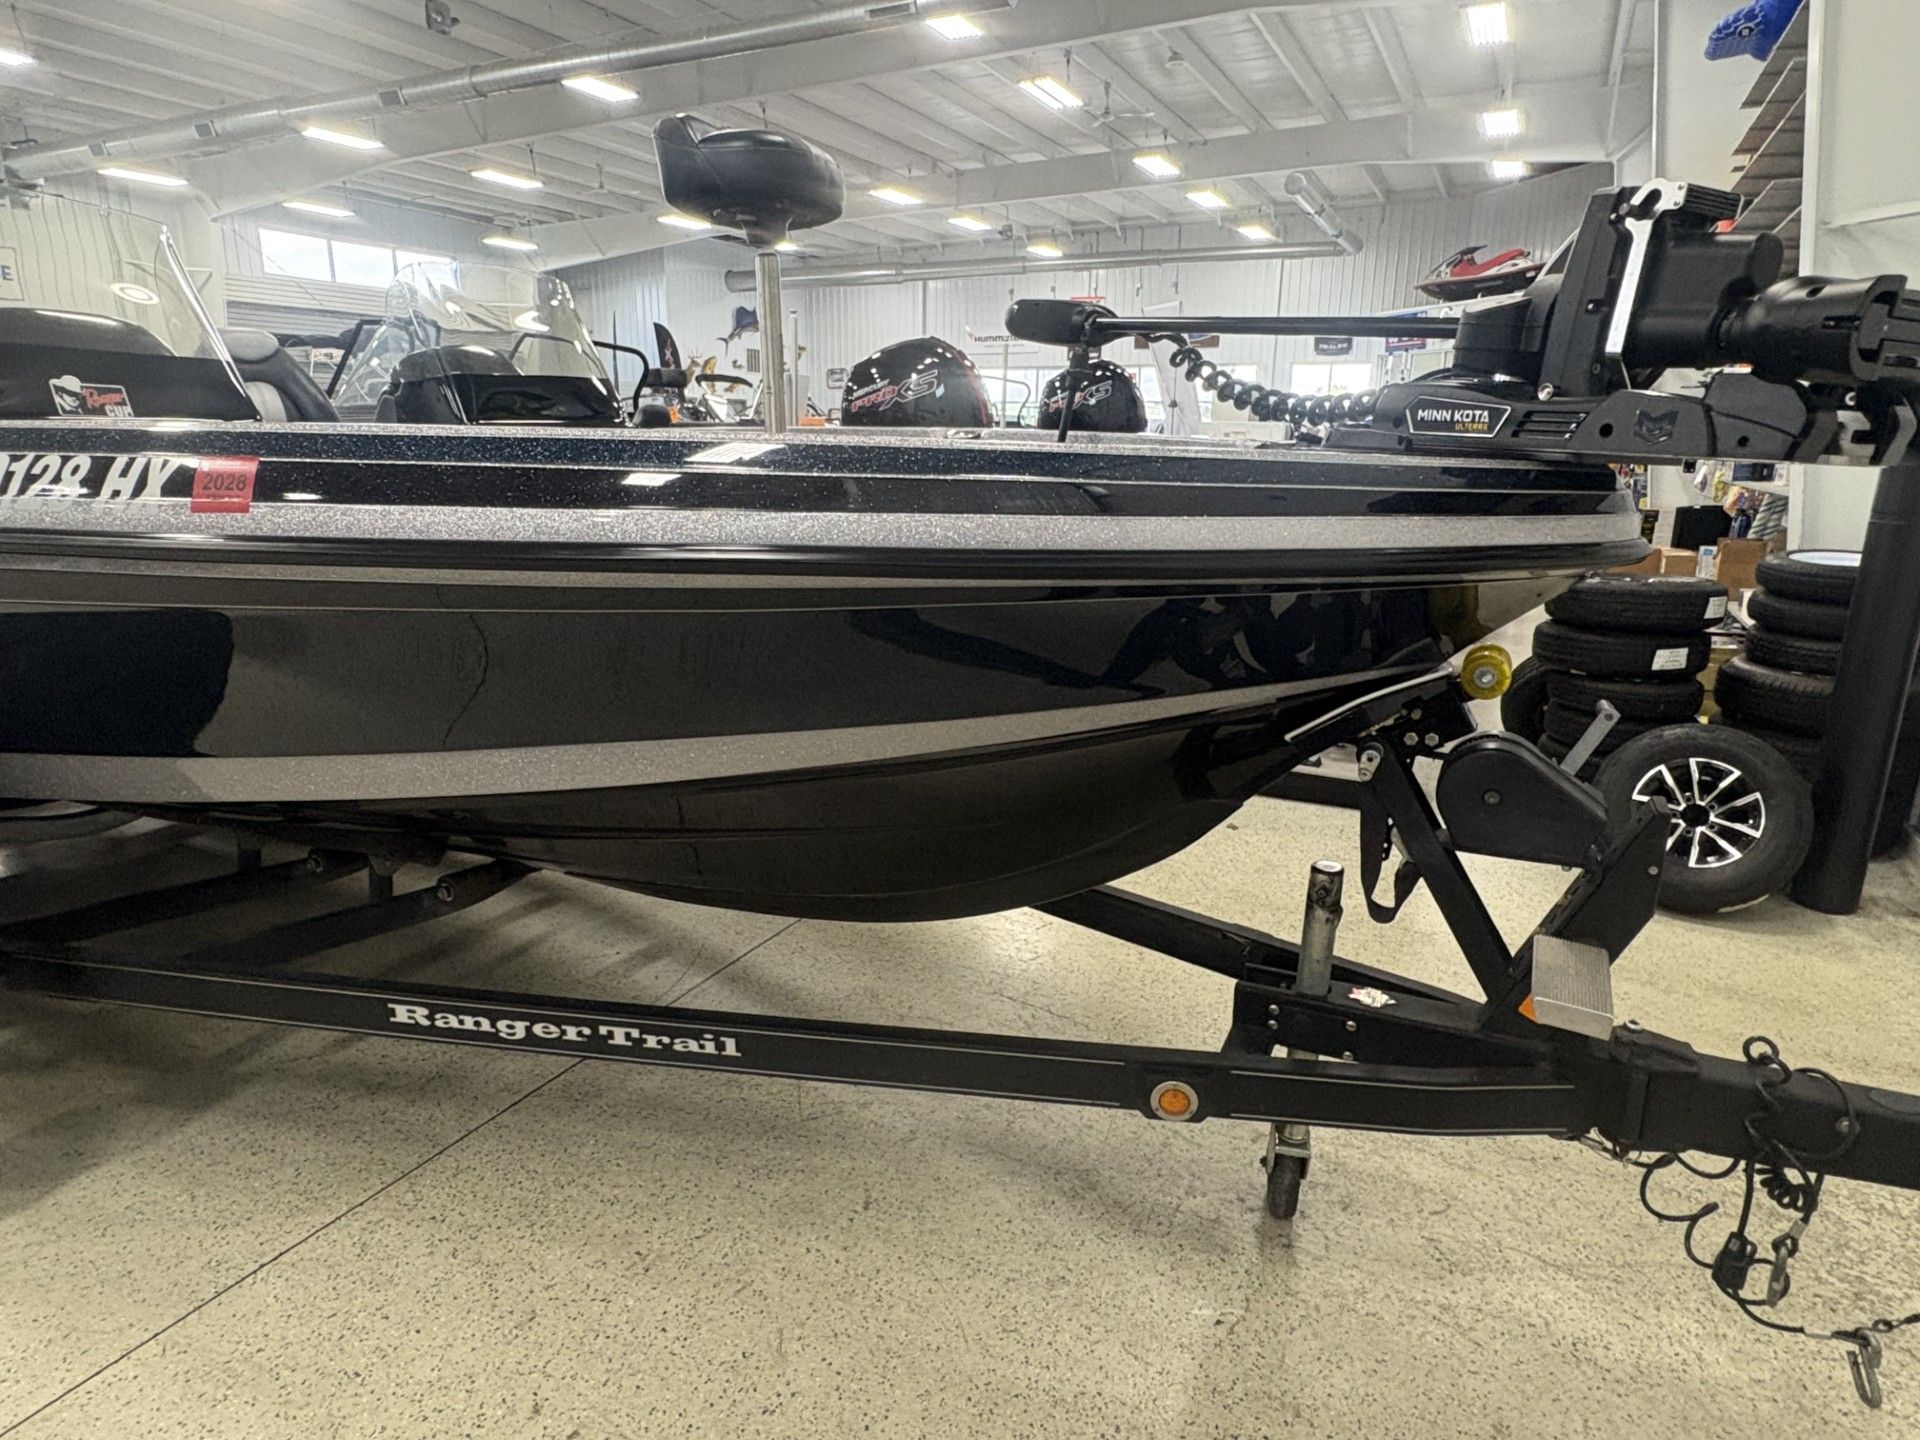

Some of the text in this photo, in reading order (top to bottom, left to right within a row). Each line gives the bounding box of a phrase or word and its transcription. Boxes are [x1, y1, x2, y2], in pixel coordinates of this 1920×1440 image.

[879, 369, 938, 411] XS
[1417, 409, 1490, 422] MINN KOTA
[202, 473, 247, 491] 2028
[387, 1003, 742, 1057] Ranger Trail
